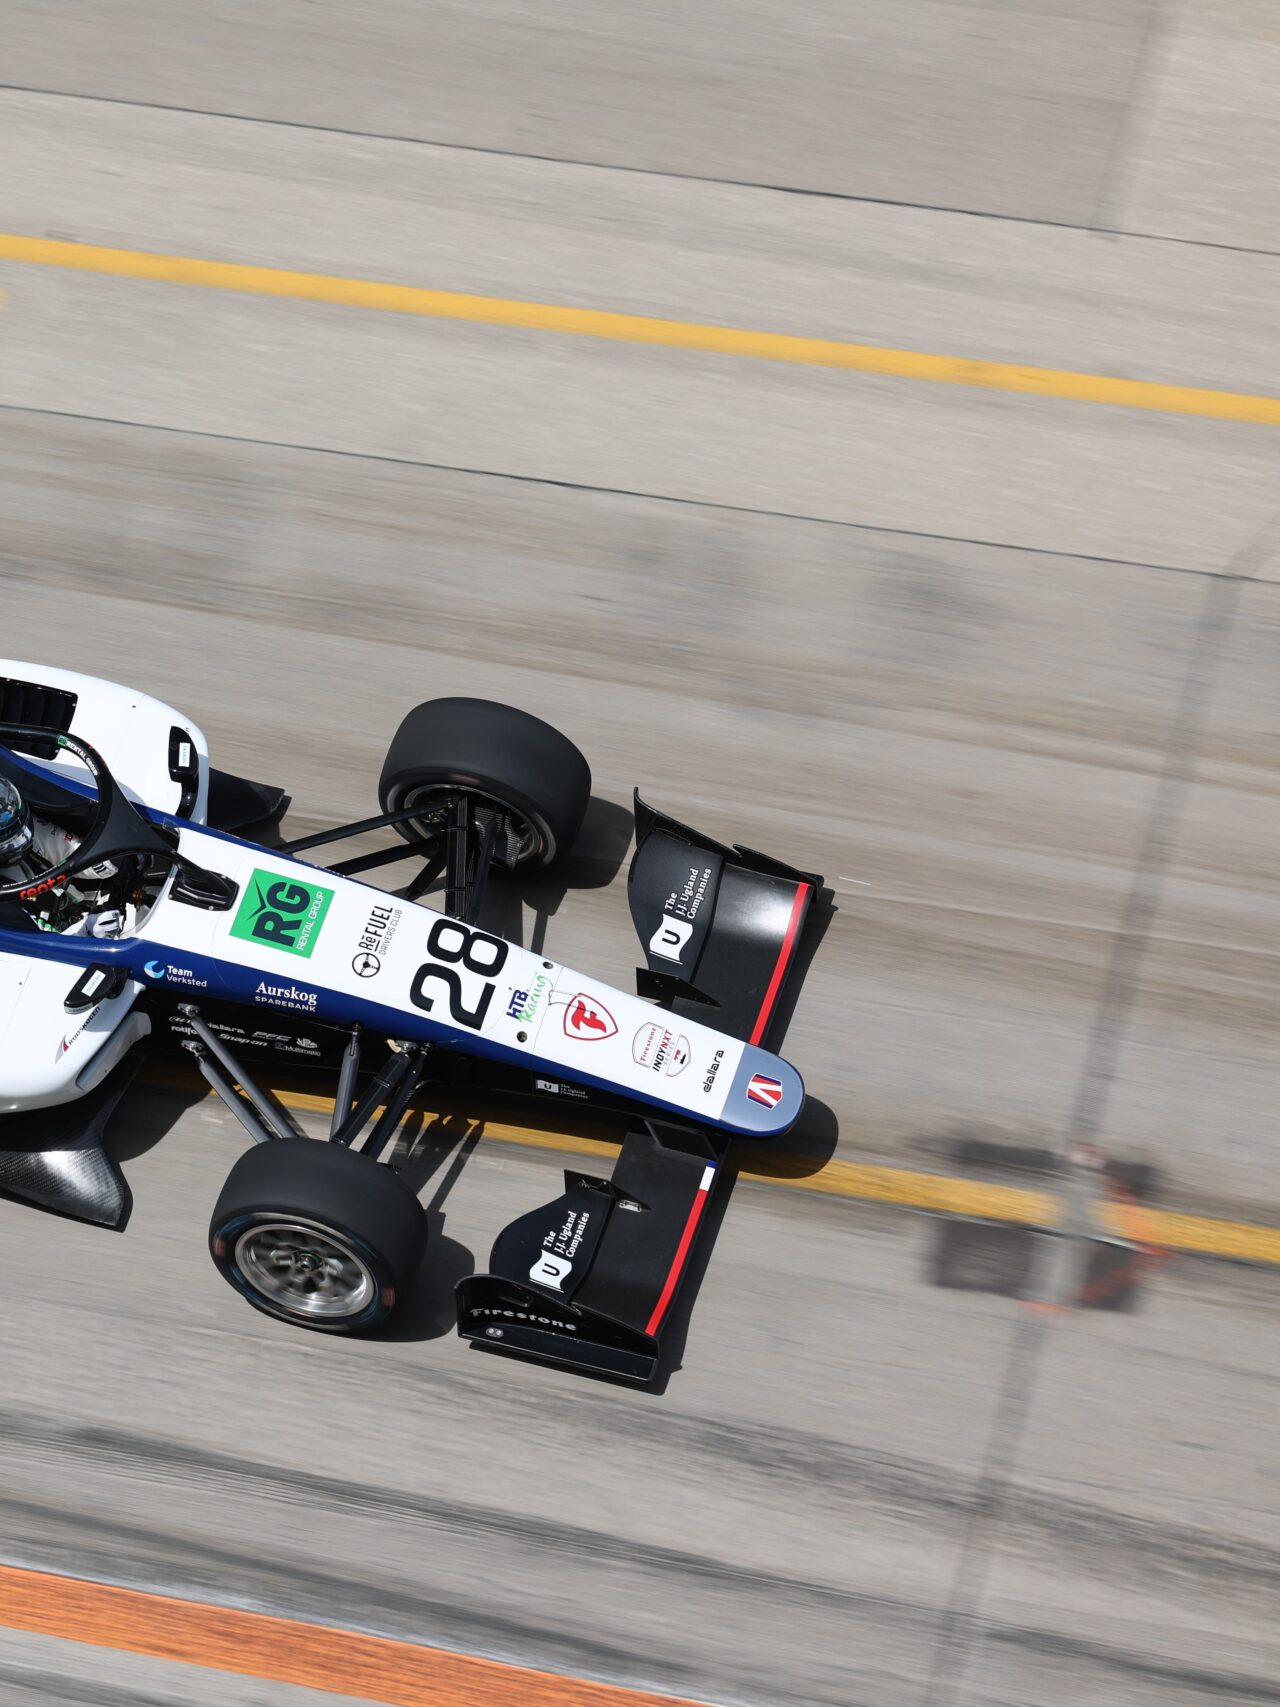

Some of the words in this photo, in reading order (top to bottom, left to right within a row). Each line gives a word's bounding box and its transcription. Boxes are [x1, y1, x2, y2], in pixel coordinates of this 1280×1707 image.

[681, 867, 700, 902] Ugland
[687, 868, 712, 919] Companies
[251, 881, 311, 947] RG
[664, 892, 677, 911] The
[296, 921, 315, 950] RENTAL
[309, 891, 324, 918] GROUP
[378, 926, 396, 955] DRIVERS
[391, 909, 403, 927] CLUB
[662, 929, 681, 946] U
[166, 974, 208, 988] Verksted
[167, 965, 193, 978] Team
[409, 918, 509, 1031] 28
[255, 995, 316, 1012] SPAREBANK
[256, 982, 318, 1005] Aurskog
[506, 989, 529, 1020] HTB
[518, 974, 553, 1023] Racing
[640, 1026, 657, 1063] Firestone
[703, 1050, 724, 1093] dallara
[543, 1230, 556, 1247] The
[558, 1211, 577, 1242] Ugland
[565, 1212, 590, 1258] Companies
[542, 1263, 561, 1277] U
[470, 1308, 577, 1331] Firestone
